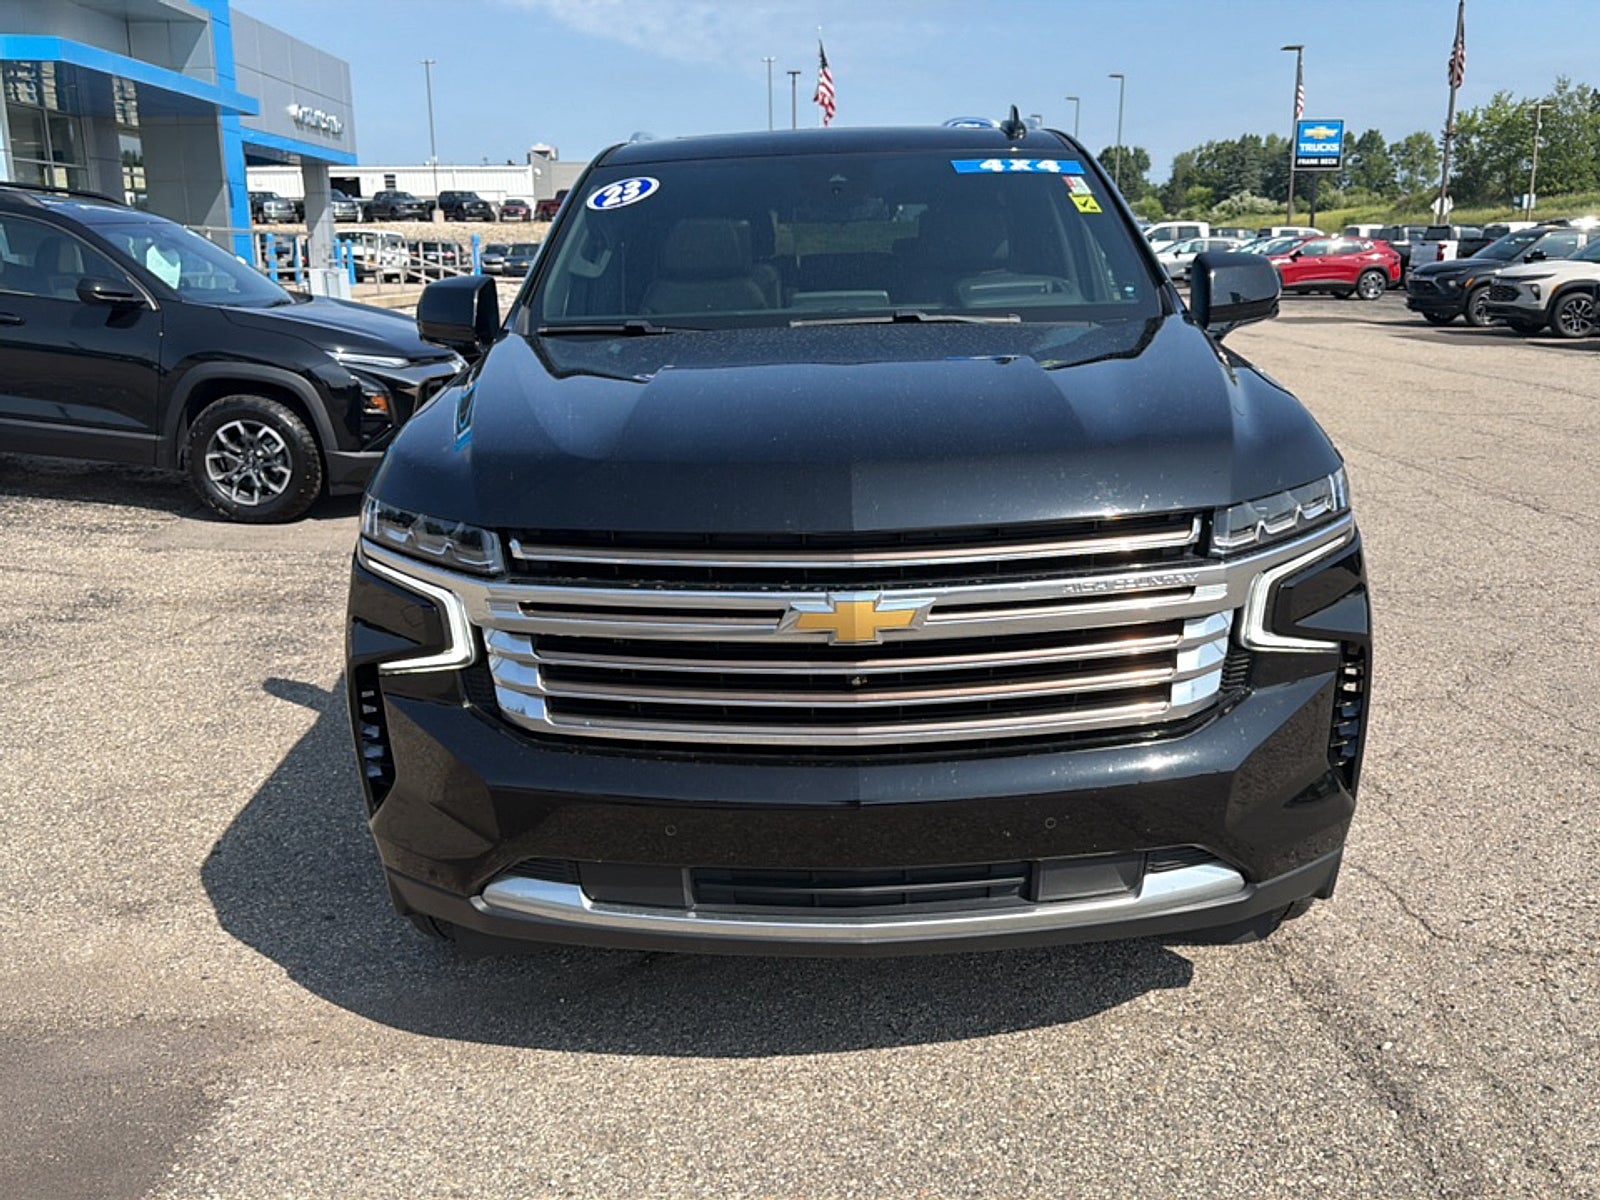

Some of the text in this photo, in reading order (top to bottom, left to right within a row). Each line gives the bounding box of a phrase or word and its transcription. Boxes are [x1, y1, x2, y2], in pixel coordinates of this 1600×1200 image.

[1298, 143, 1340, 152] TRUCKS
[602, 181, 642, 207] 23
[1113, 573, 1200, 591] COUNTRY
